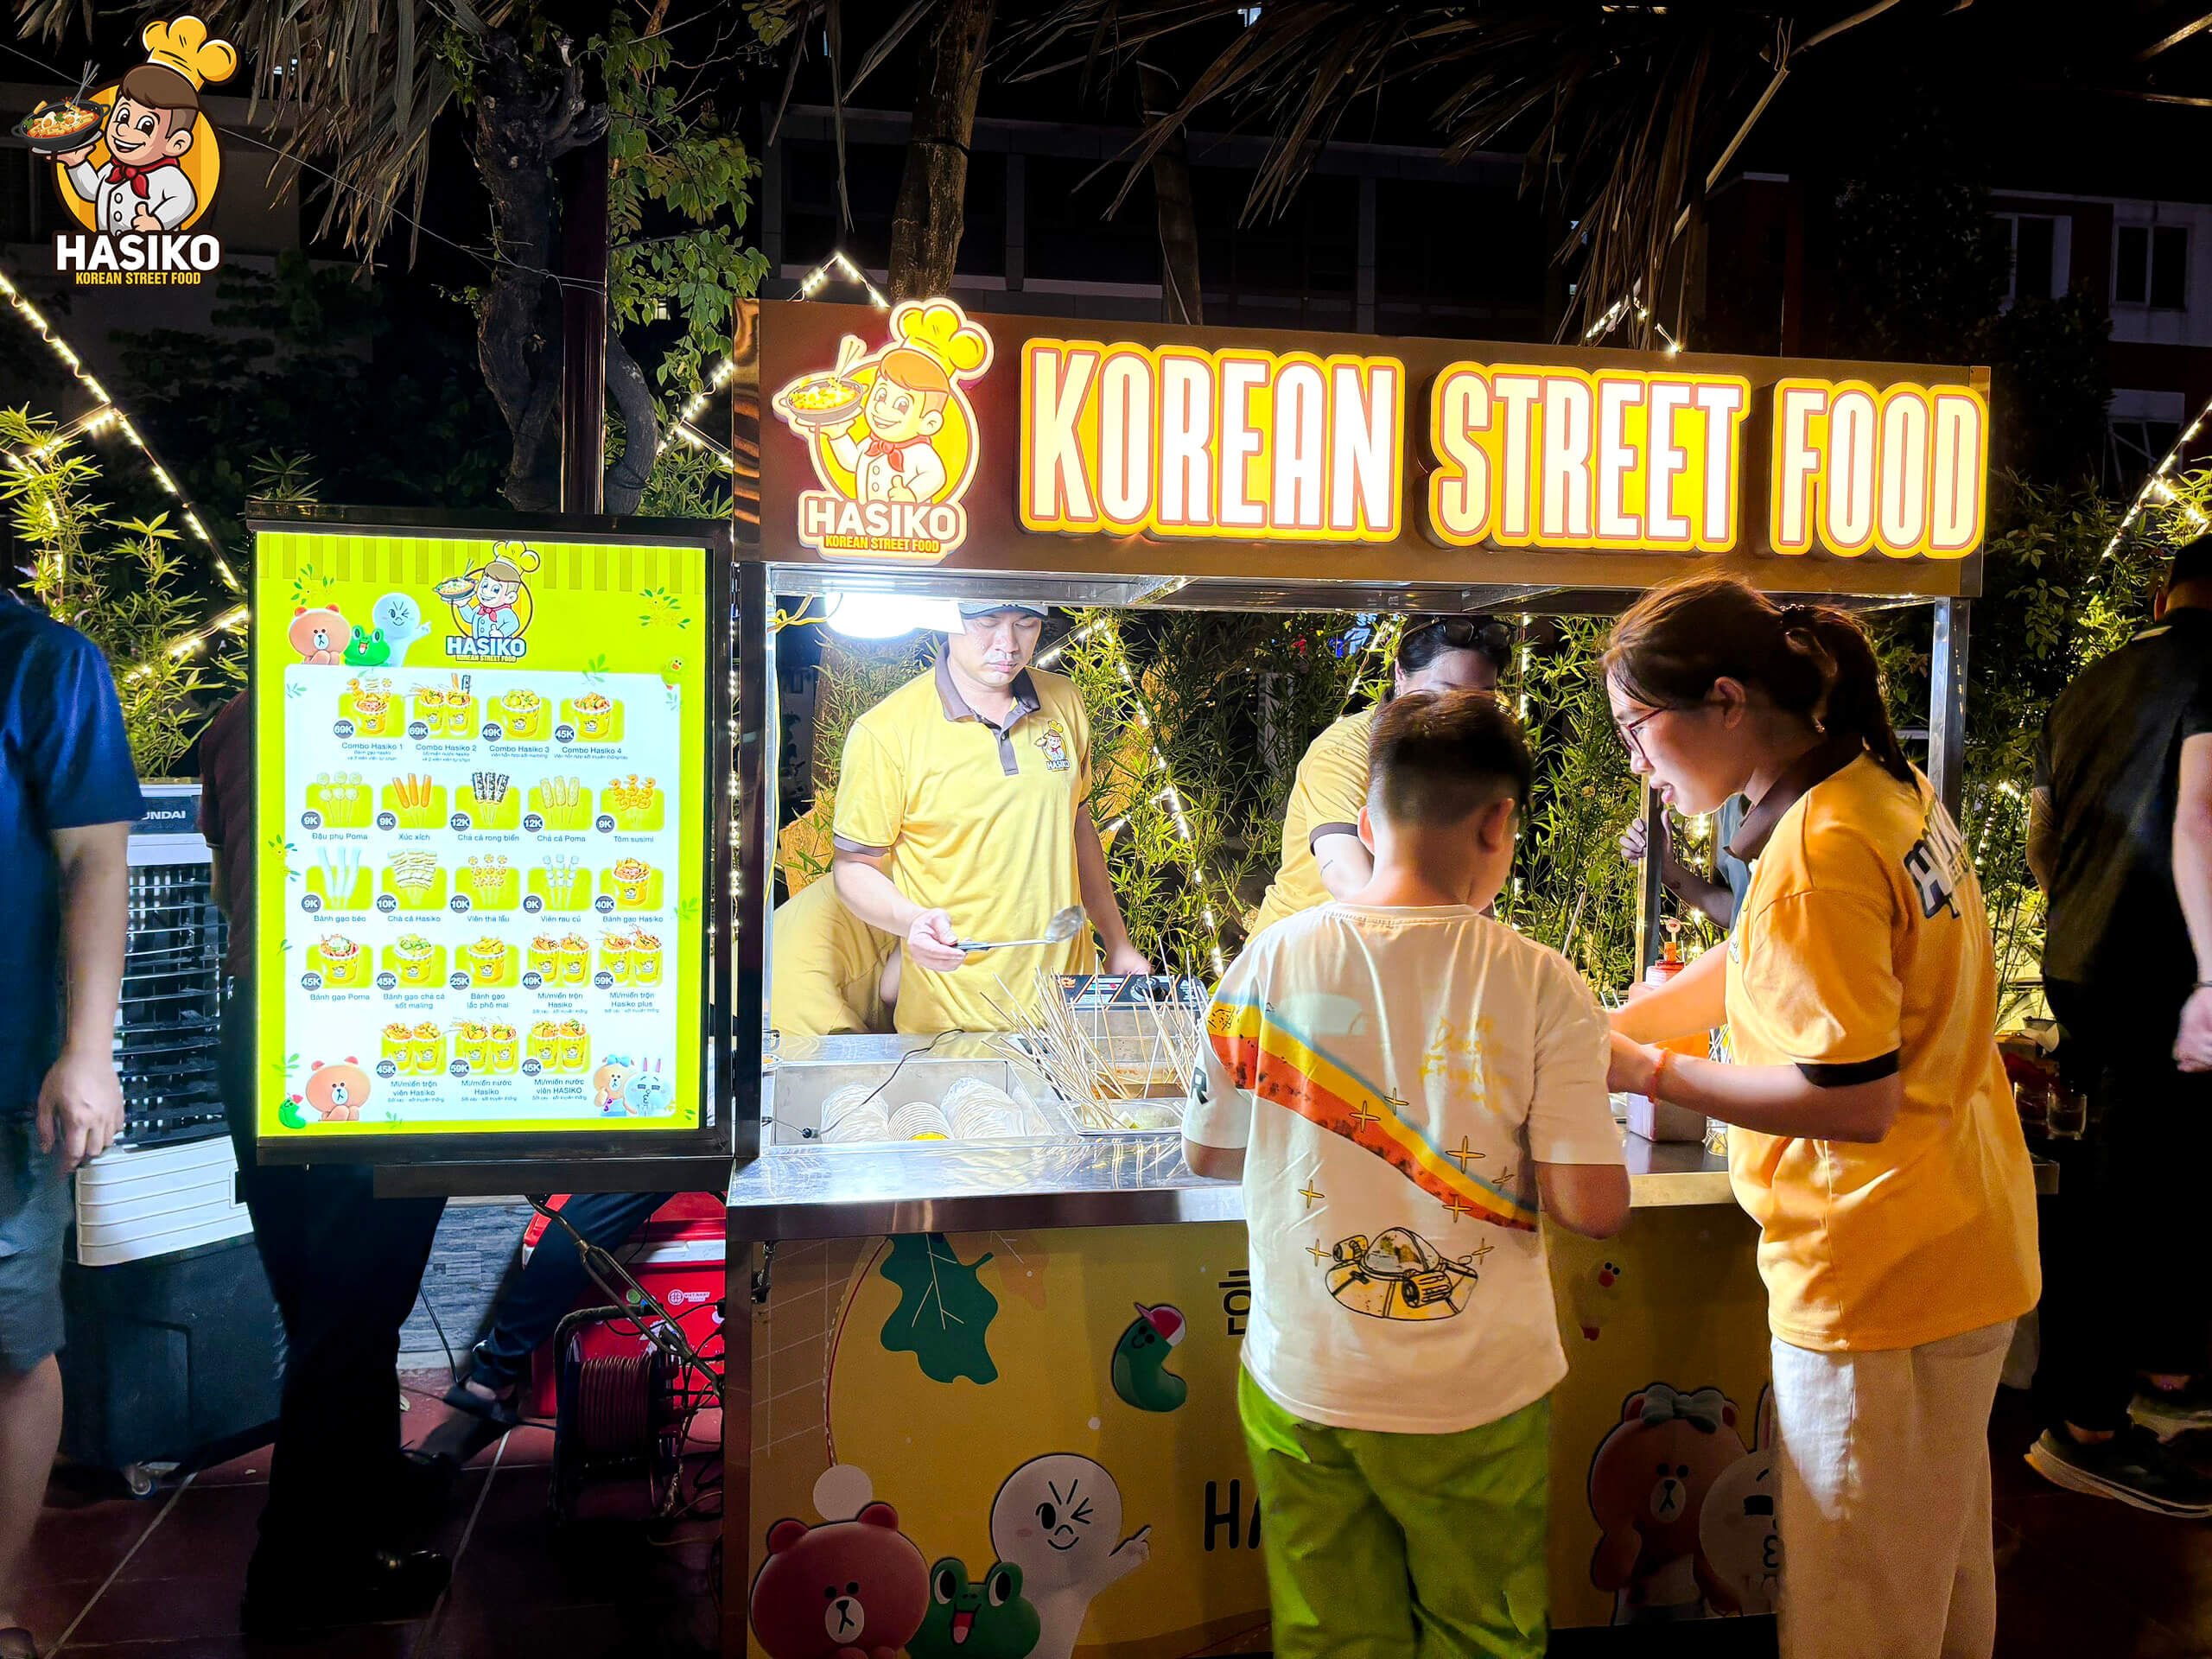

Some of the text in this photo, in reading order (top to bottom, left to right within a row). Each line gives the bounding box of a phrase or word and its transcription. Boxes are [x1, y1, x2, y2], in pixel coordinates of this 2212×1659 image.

[1028, 346, 1983, 550] KOREAN STREET FOOD
[807, 499, 957, 540] HASIKO
[825, 535, 940, 552] KOREAN STREET FOOD
[447, 637, 525, 657] HASIKO
[334, 725, 353, 734] 69K
[482, 728, 502, 736] 49K
[555, 729, 575, 738] 45K
[303, 817, 319, 825] 9K
[379, 817, 394, 826] 9K
[451, 818, 469, 827] 12K
[524, 819, 543, 828] 12K
[598, 820, 613, 829] 9K
[485, 835, 502, 843] rong
[303, 899, 319, 908] 9K
[450, 900, 470, 909] 10K
[525, 900, 540, 909] 9K
[302, 977, 321, 986] 45K
[377, 977, 397, 986] 45K
[450, 977, 469, 986] 25K
[523, 977, 542, 986] 49K
[594, 976, 613, 985] 59K
[377, 1065, 396, 1073] 45K
[450, 1064, 469, 1072] 59K
[522, 1063, 541, 1072] 45K
